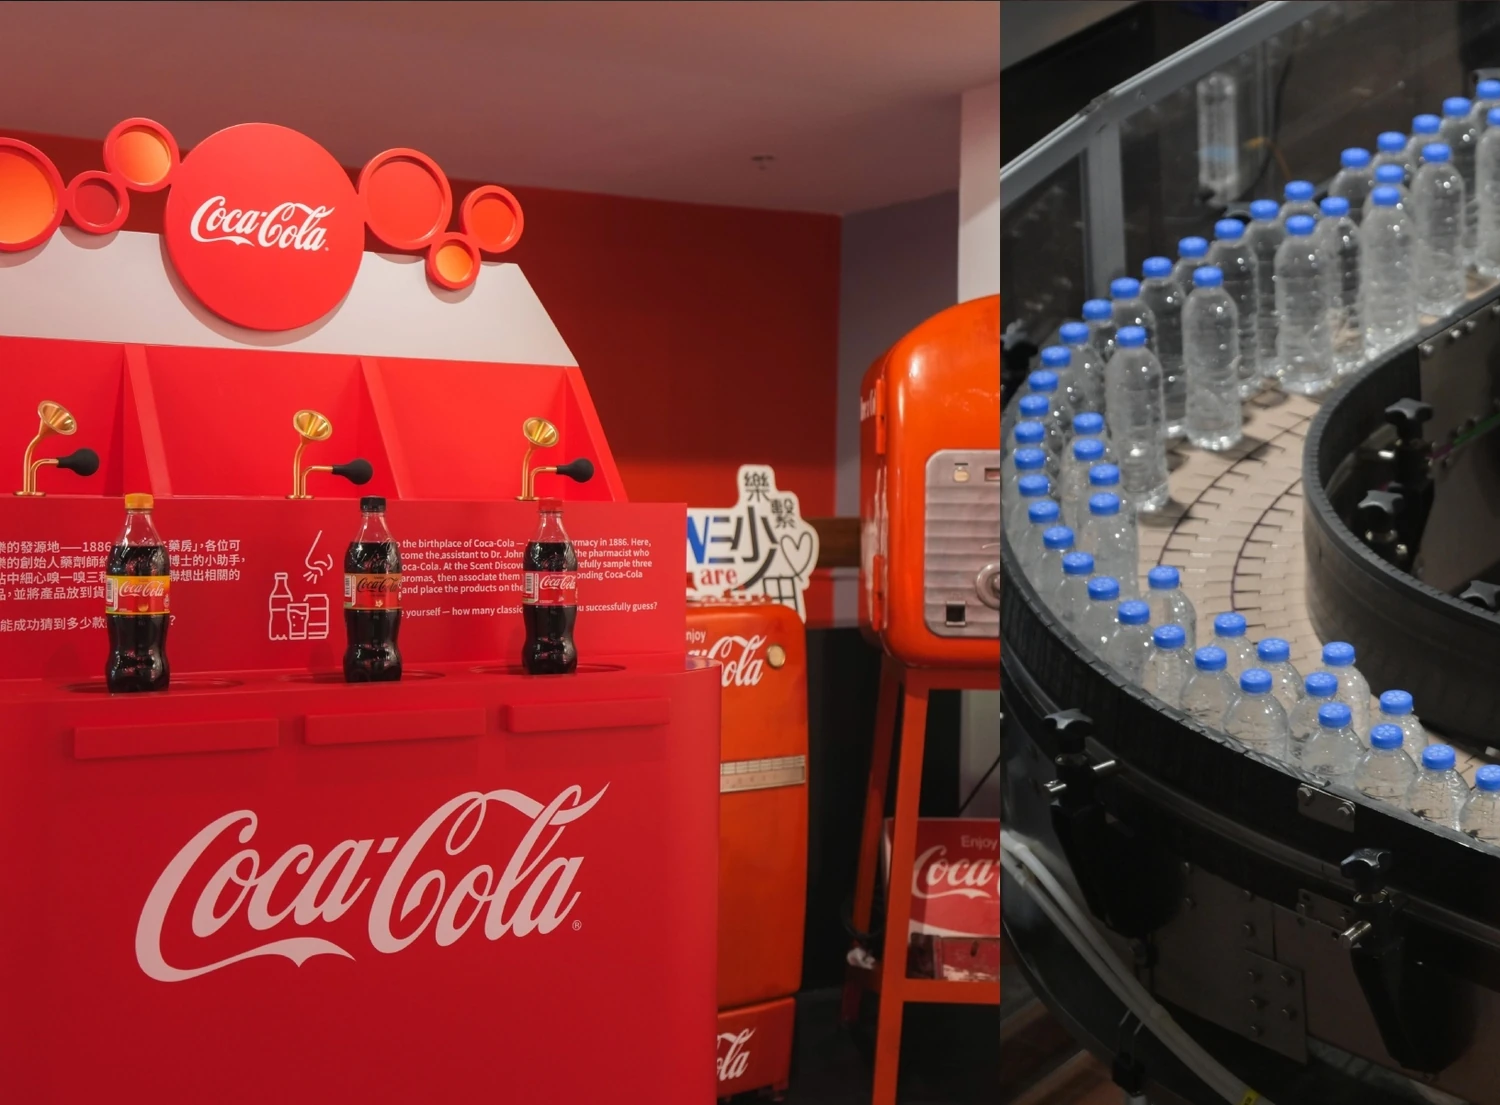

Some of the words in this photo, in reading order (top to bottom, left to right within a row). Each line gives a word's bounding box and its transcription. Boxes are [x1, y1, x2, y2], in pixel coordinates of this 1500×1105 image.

[189, 195, 335, 253] Coca-Cola
[403, 539, 416, 548] the
[419, 539, 462, 549] birthplace
[464, 539, 472, 547] of
[474, 539, 515, 547] Coca-Cola
[600, 538, 607, 546] in
[609, 538, 629, 546] 1886.
[631, 538, 651, 547] Here,
[426, 551, 439, 559] the
[442, 551, 478, 559] assistant
[491, 550, 502, 558] Dr.
[504, 550, 524, 558] John
[588, 549, 635, 558] pharmacist
[636, 548, 650, 556] who
[402, 562, 441, 571] oca-Cola.
[443, 562, 452, 570] At
[454, 562, 468, 570] the
[470, 561, 493, 569] Scent
[603, 559, 631, 568] sample
[632, 559, 652, 567] three
[402, 575, 436, 584] aromas,
[438, 573, 457, 582] then
[459, 573, 497, 581] associate
[499, 572, 520, 581] them
[604, 570, 643, 578] Coca-Cola
[539, 574, 576, 590] Coca-Cola
[702, 569, 738, 588] are
[119, 580, 165, 597] Coca-Cola
[402, 585, 418, 593] and
[420, 585, 443, 595] place
[445, 585, 459, 593] the
[460, 584, 497, 594] products
[406, 607, 441, 618] yourself
[452, 607, 470, 615] how
[472, 607, 495, 616] many
[585, 603, 631, 612] successfully
[632, 602, 657, 612] guess?
[686, 628, 706, 644] njoy
[961, 834, 998, 850] Enjoy
[134, 780, 611, 983] Coca-Cola
